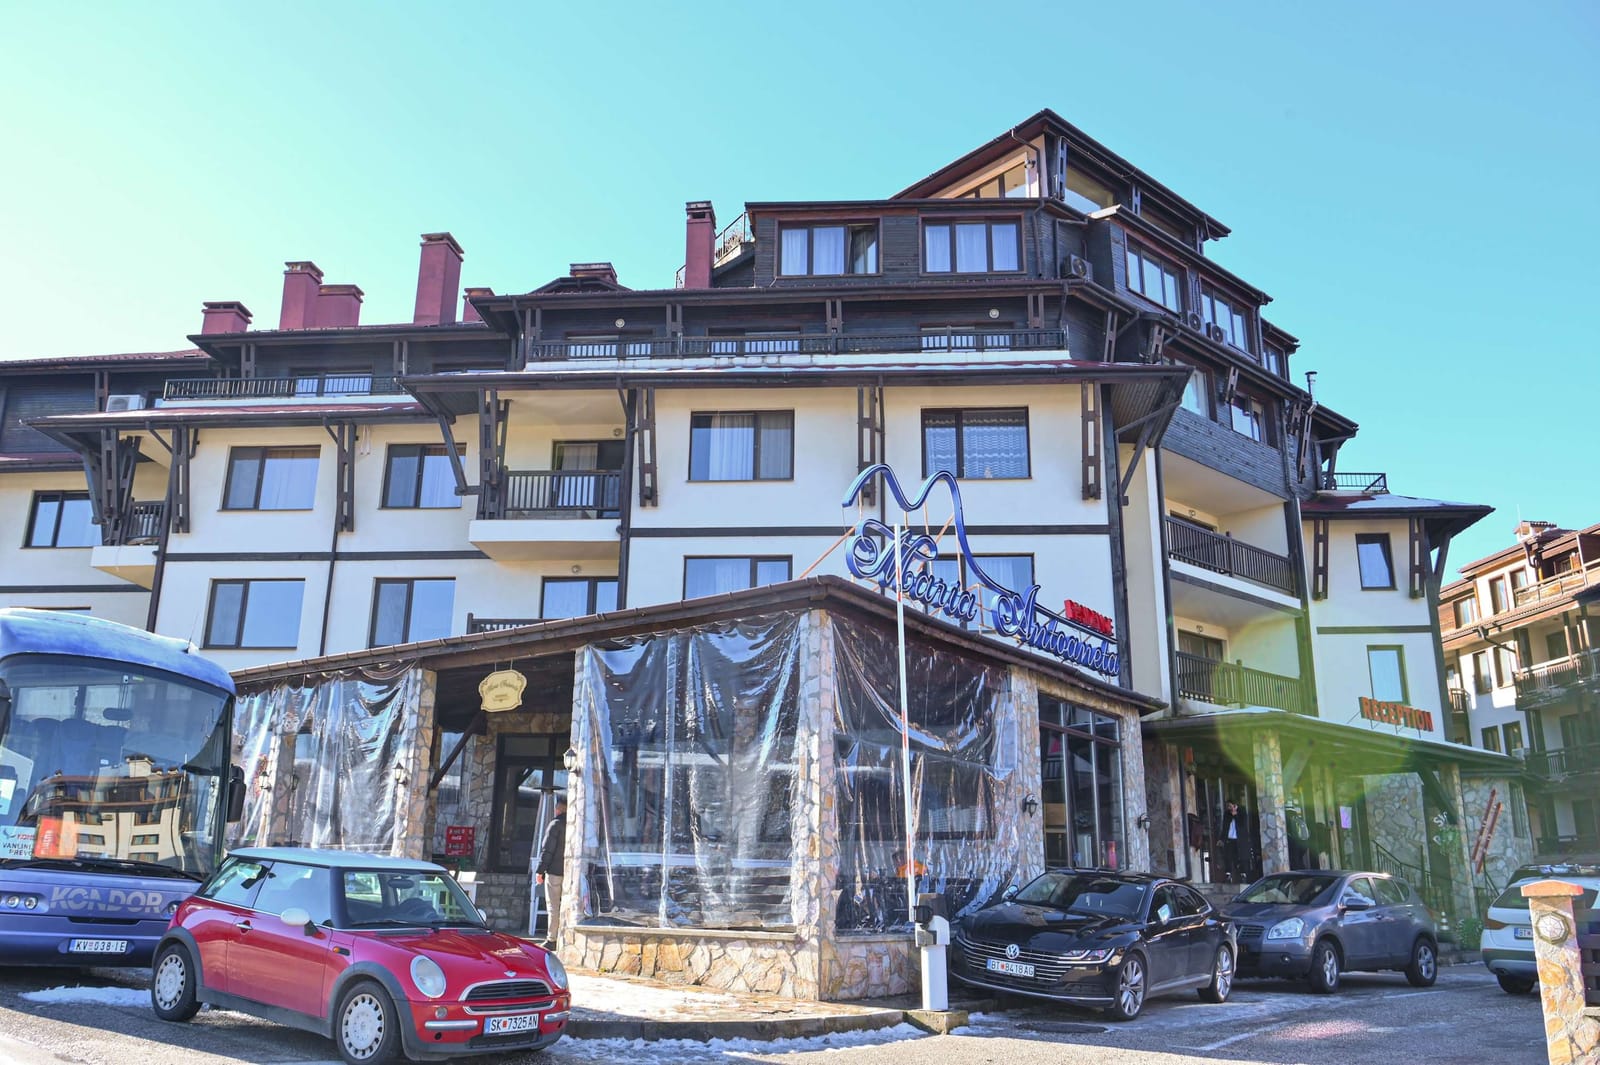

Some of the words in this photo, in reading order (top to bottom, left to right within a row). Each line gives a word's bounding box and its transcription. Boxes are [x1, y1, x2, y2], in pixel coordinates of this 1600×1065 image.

[846, 518, 977, 622] Maria
[991, 585, 1119, 676] Antoaneta
[1358, 697, 1434, 732] RECEPTION
[49, 887, 163, 914] KONDOR
[491, 1018, 502, 1031] SK
